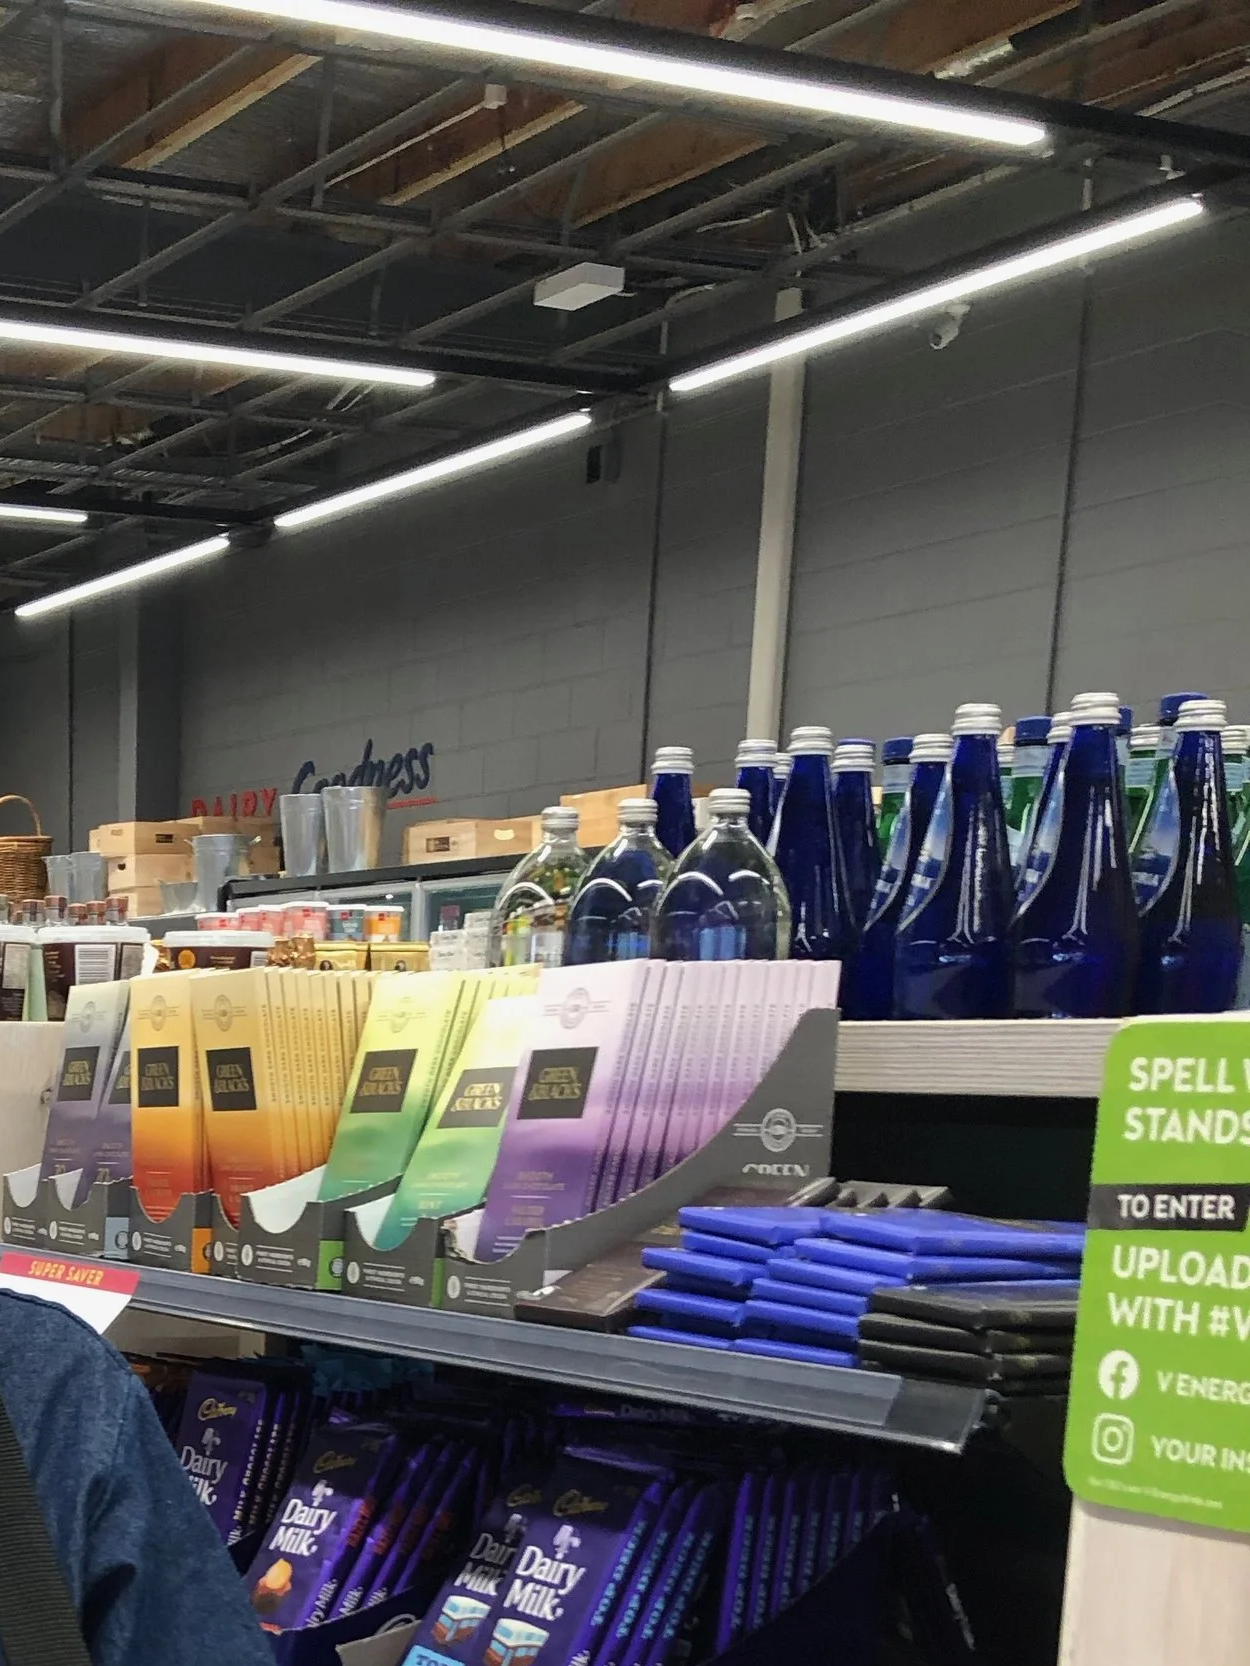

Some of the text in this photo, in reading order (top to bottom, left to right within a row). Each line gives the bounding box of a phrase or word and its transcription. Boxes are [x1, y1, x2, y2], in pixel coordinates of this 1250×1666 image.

[1129, 1056, 1236, 1094] SPELL
[1118, 1193, 1236, 1221] TO ENTER
[28, 1260, 105, 1287] SUPER SAVER
[1111, 1244, 1250, 1291] UPLOAD
[1108, 1292, 1201, 1336] WITH
[1156, 1370, 1174, 1393] V
[180, 1445, 228, 1485] Dairy
[1151, 1434, 1217, 1466] YOUR
[188, 1475, 218, 1506] ilk
[281, 1498, 338, 1536] Dairy
[268, 1526, 318, 1557] Milk
[469, 1532, 517, 1566] Dair
[515, 1545, 586, 1595] Dairy
[503, 1578, 565, 1622] Milk
